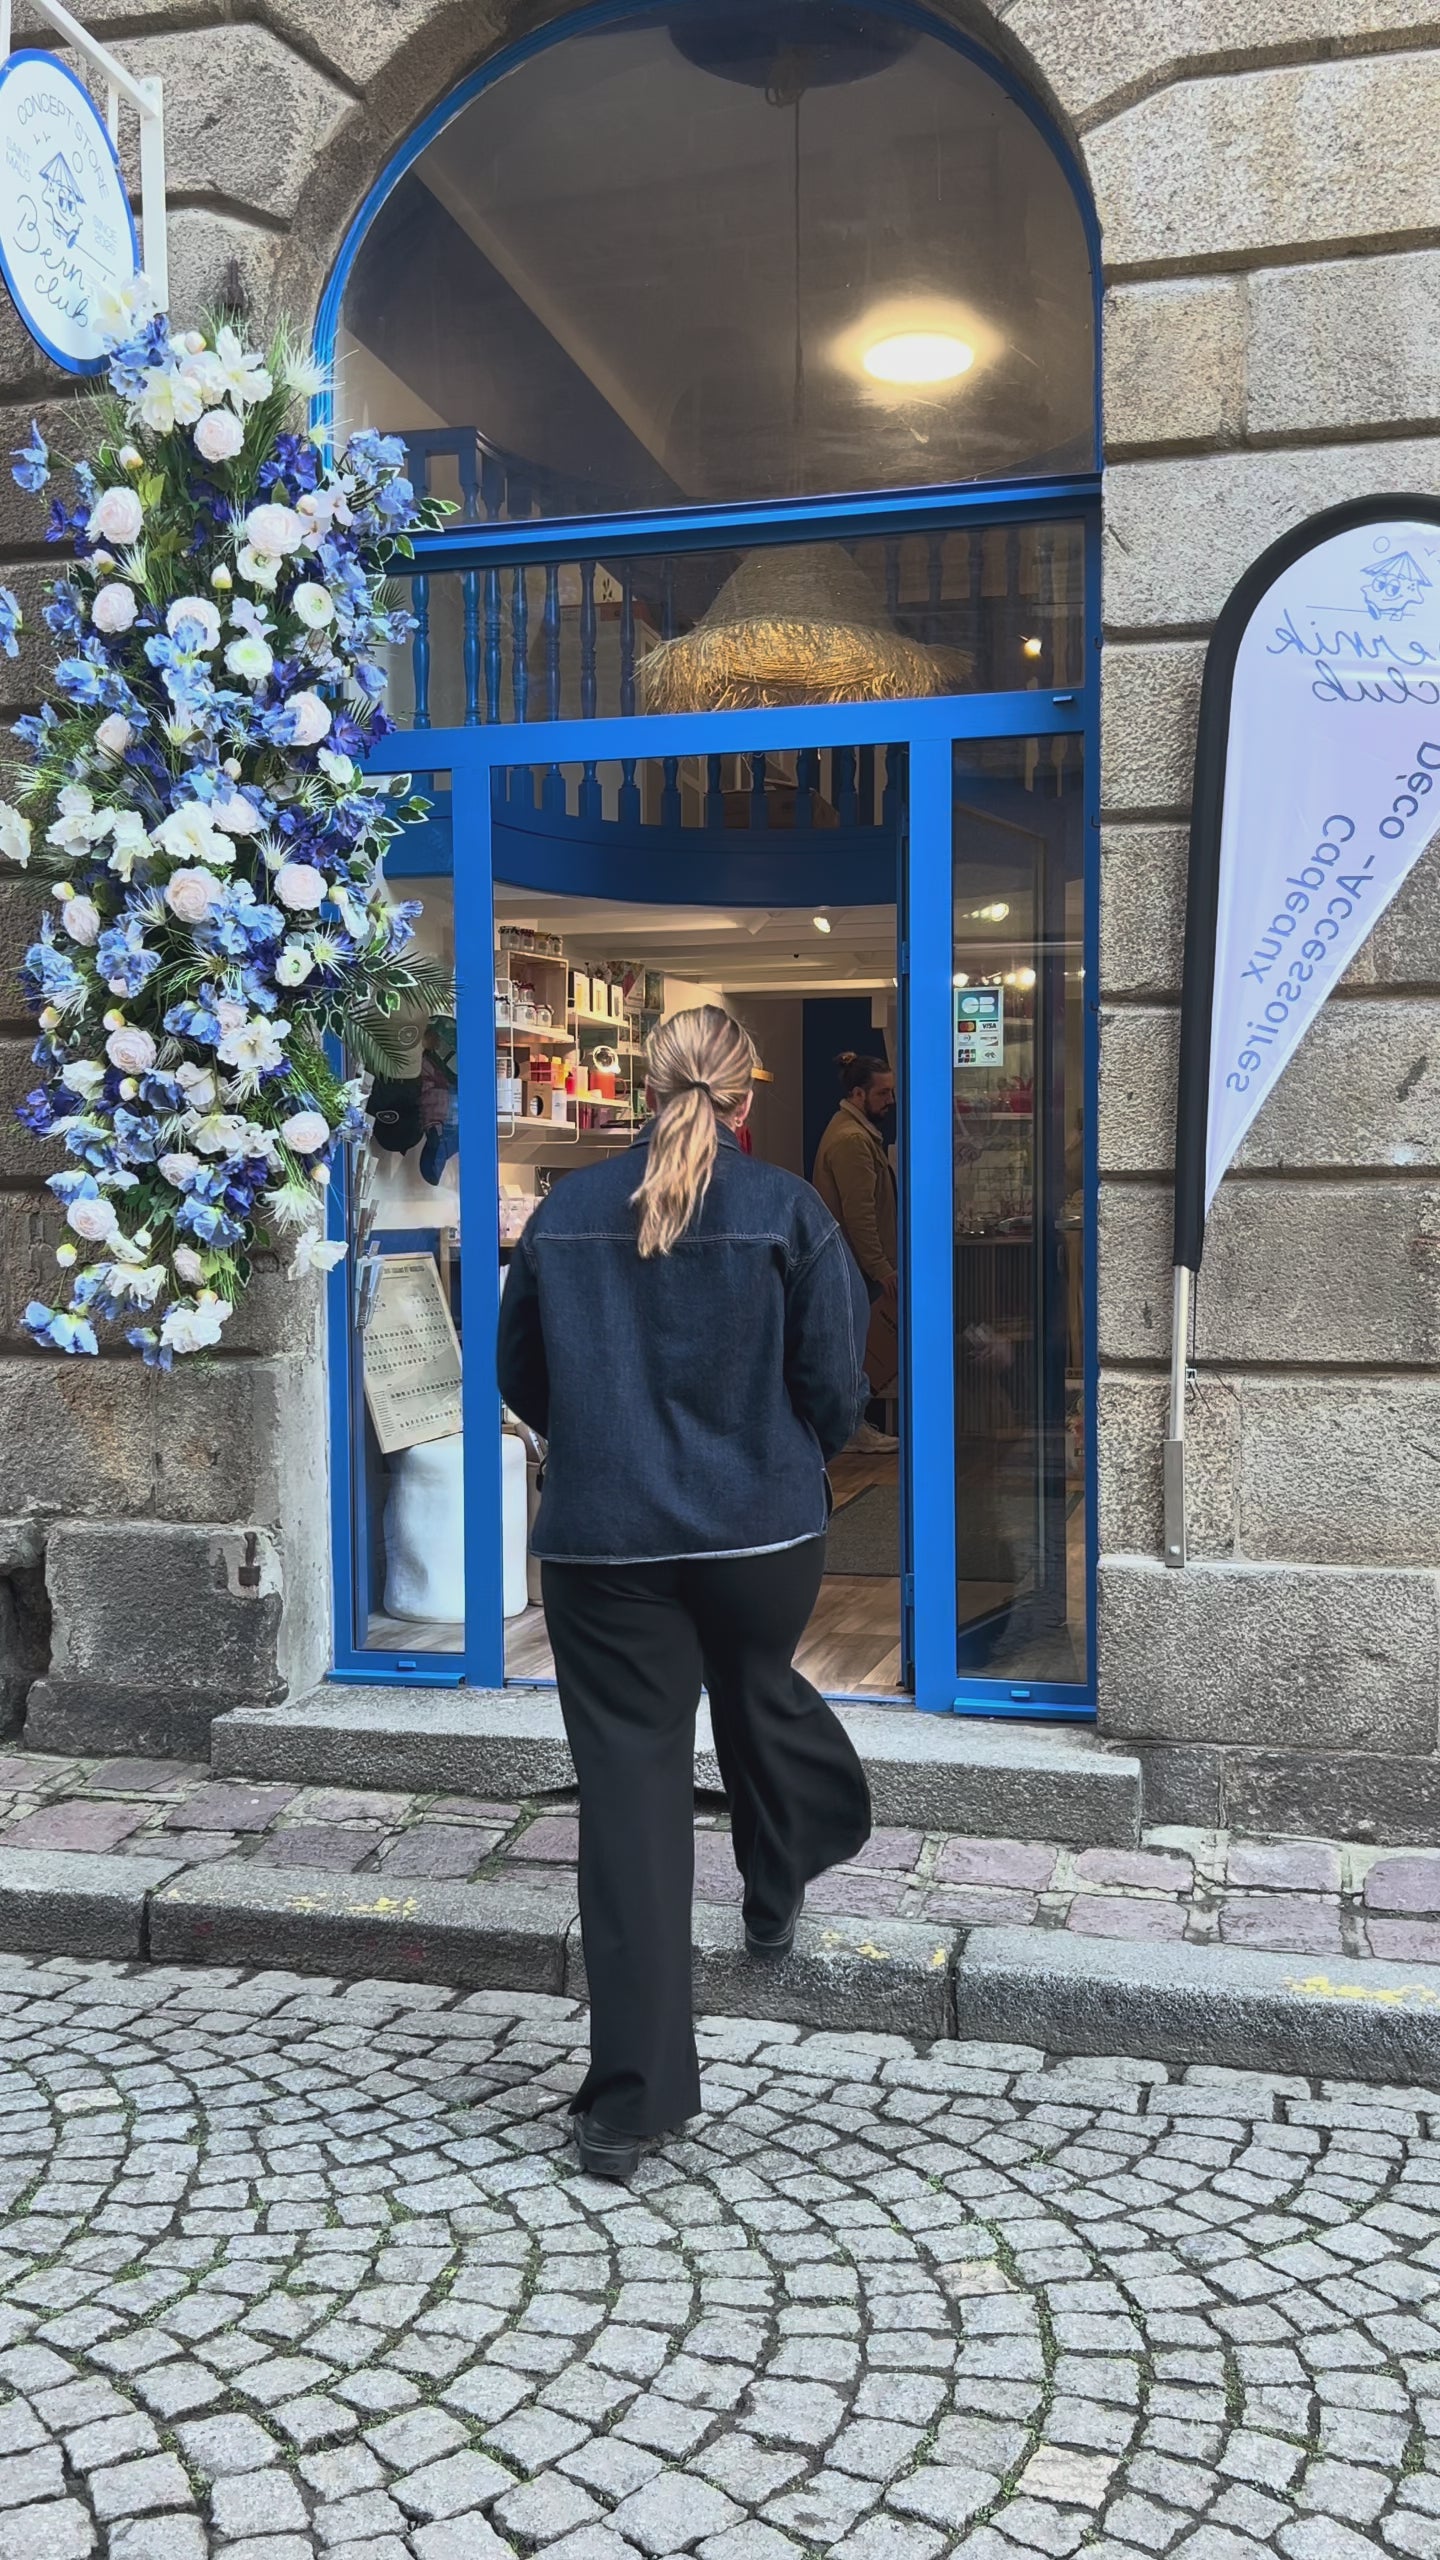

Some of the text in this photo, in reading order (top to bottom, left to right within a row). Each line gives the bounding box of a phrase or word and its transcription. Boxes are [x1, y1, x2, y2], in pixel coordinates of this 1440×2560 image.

[17, 92, 111, 200] CONCEPT STORE
[13, 194, 90, 298] Bern
